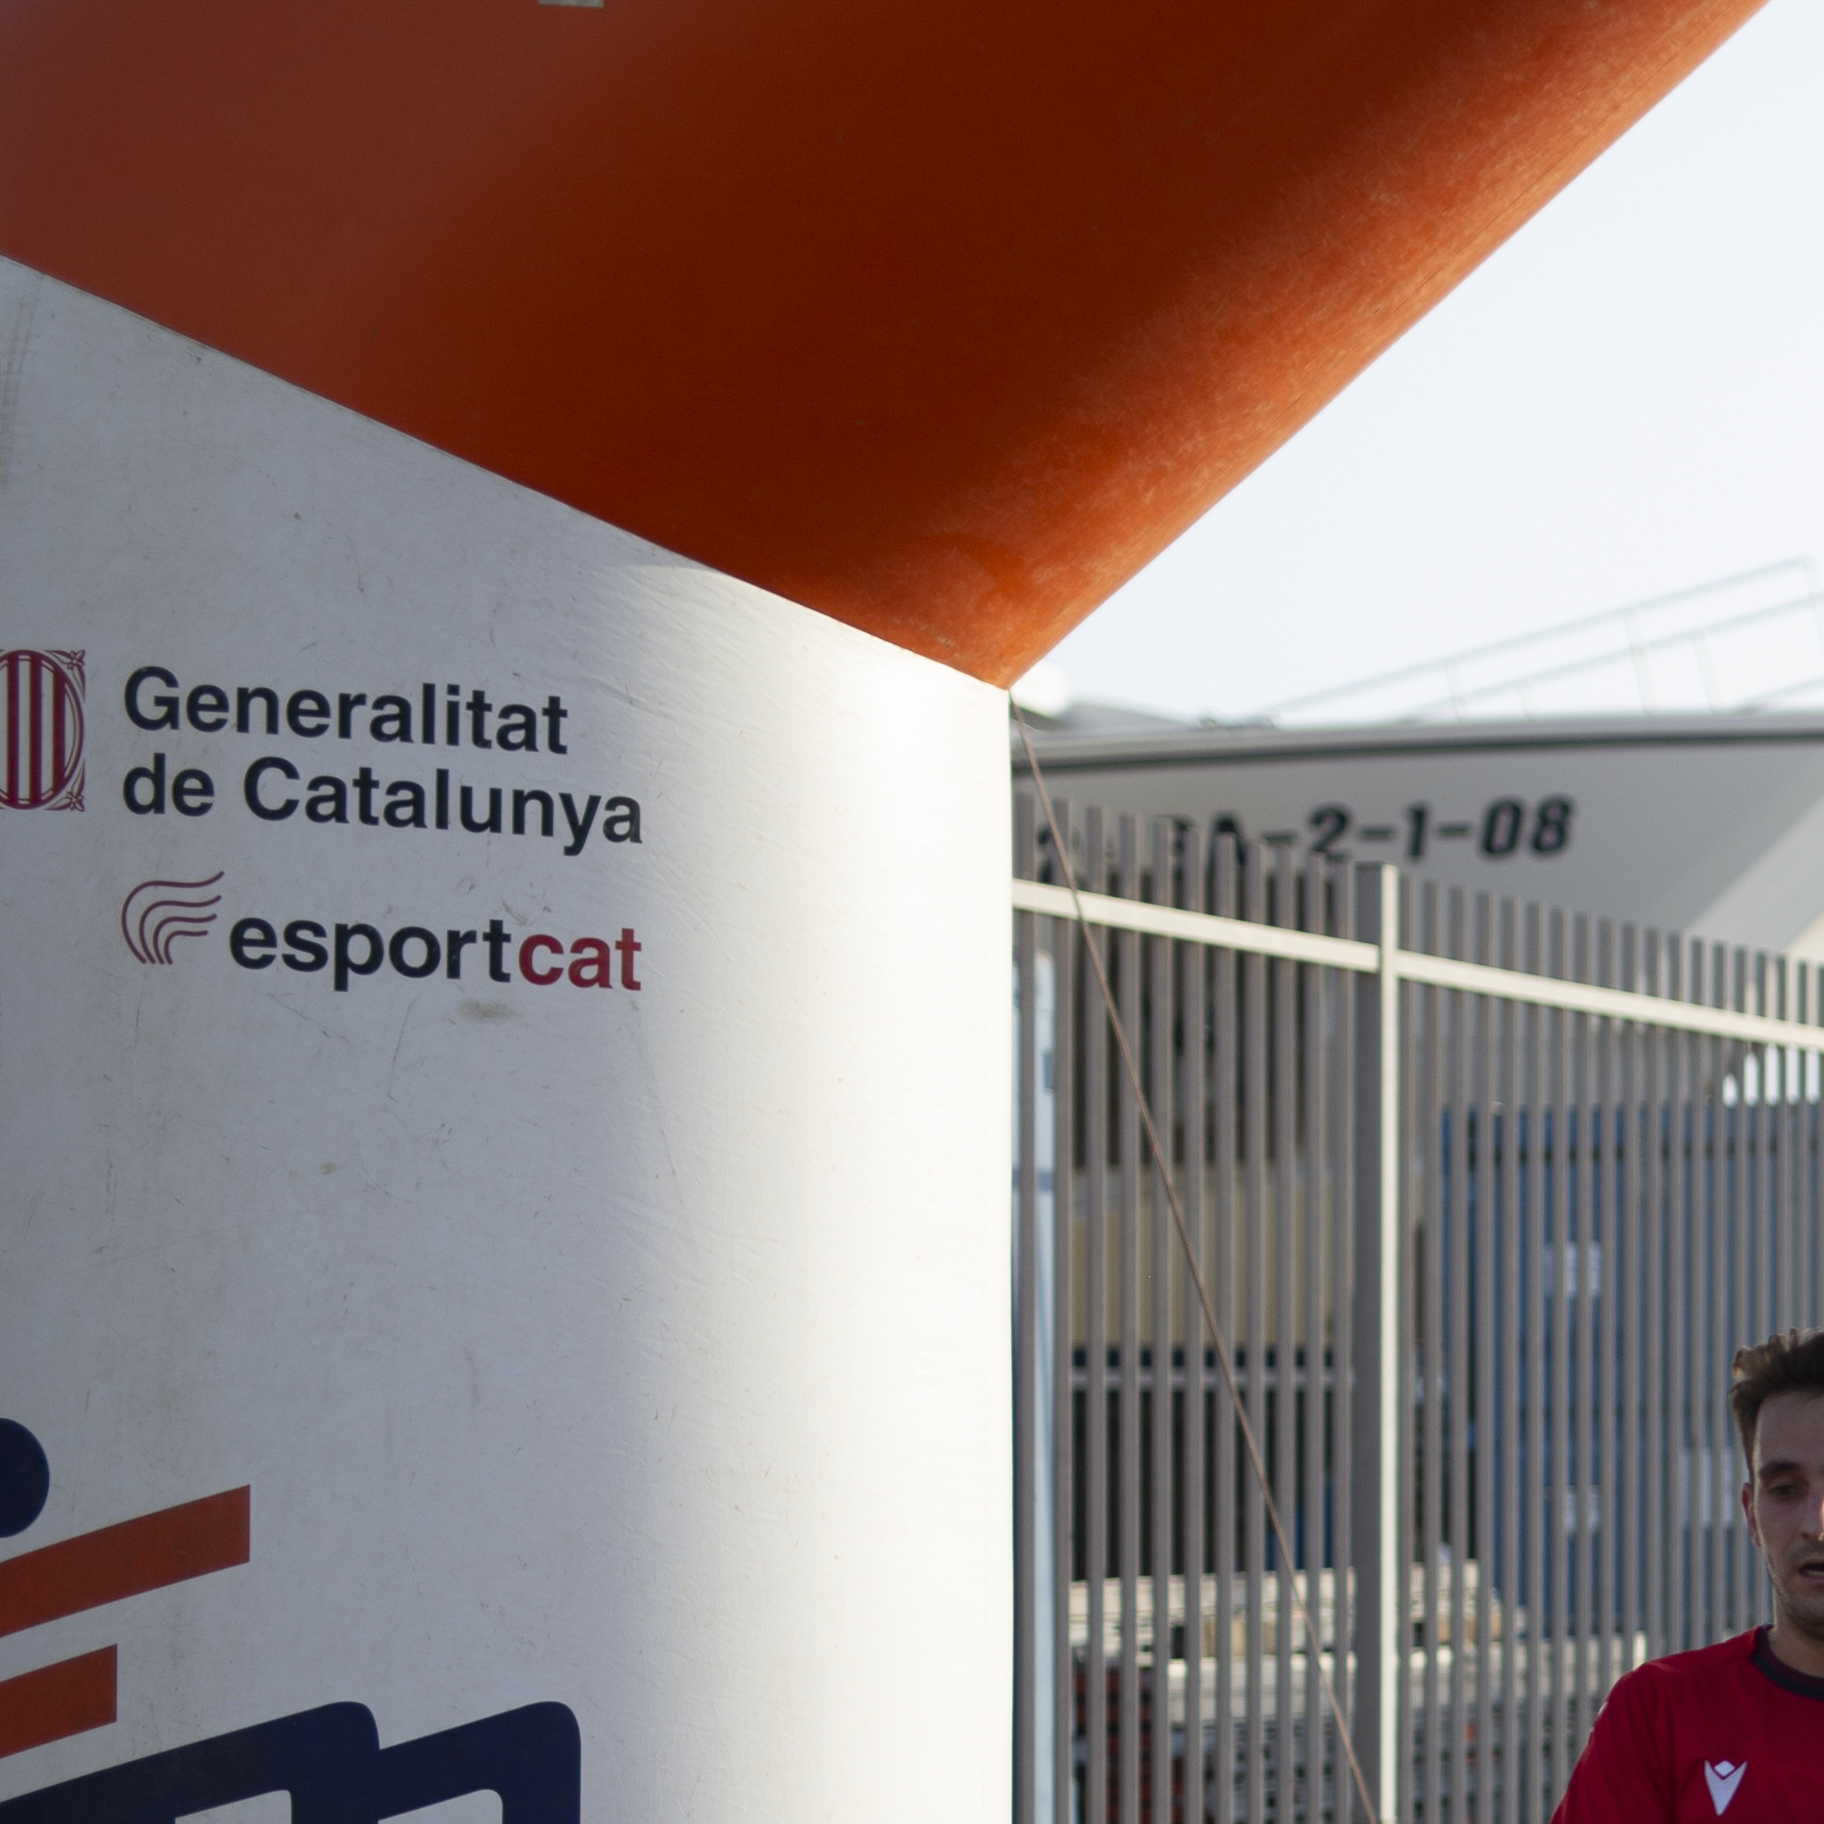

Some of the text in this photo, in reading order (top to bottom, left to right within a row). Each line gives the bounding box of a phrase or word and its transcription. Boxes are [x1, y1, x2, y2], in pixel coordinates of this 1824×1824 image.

[123, 665, 569, 755] Generalitat
[122, 752, 643, 856] de Catalunya
[229, 912, 642, 992] esportcat
